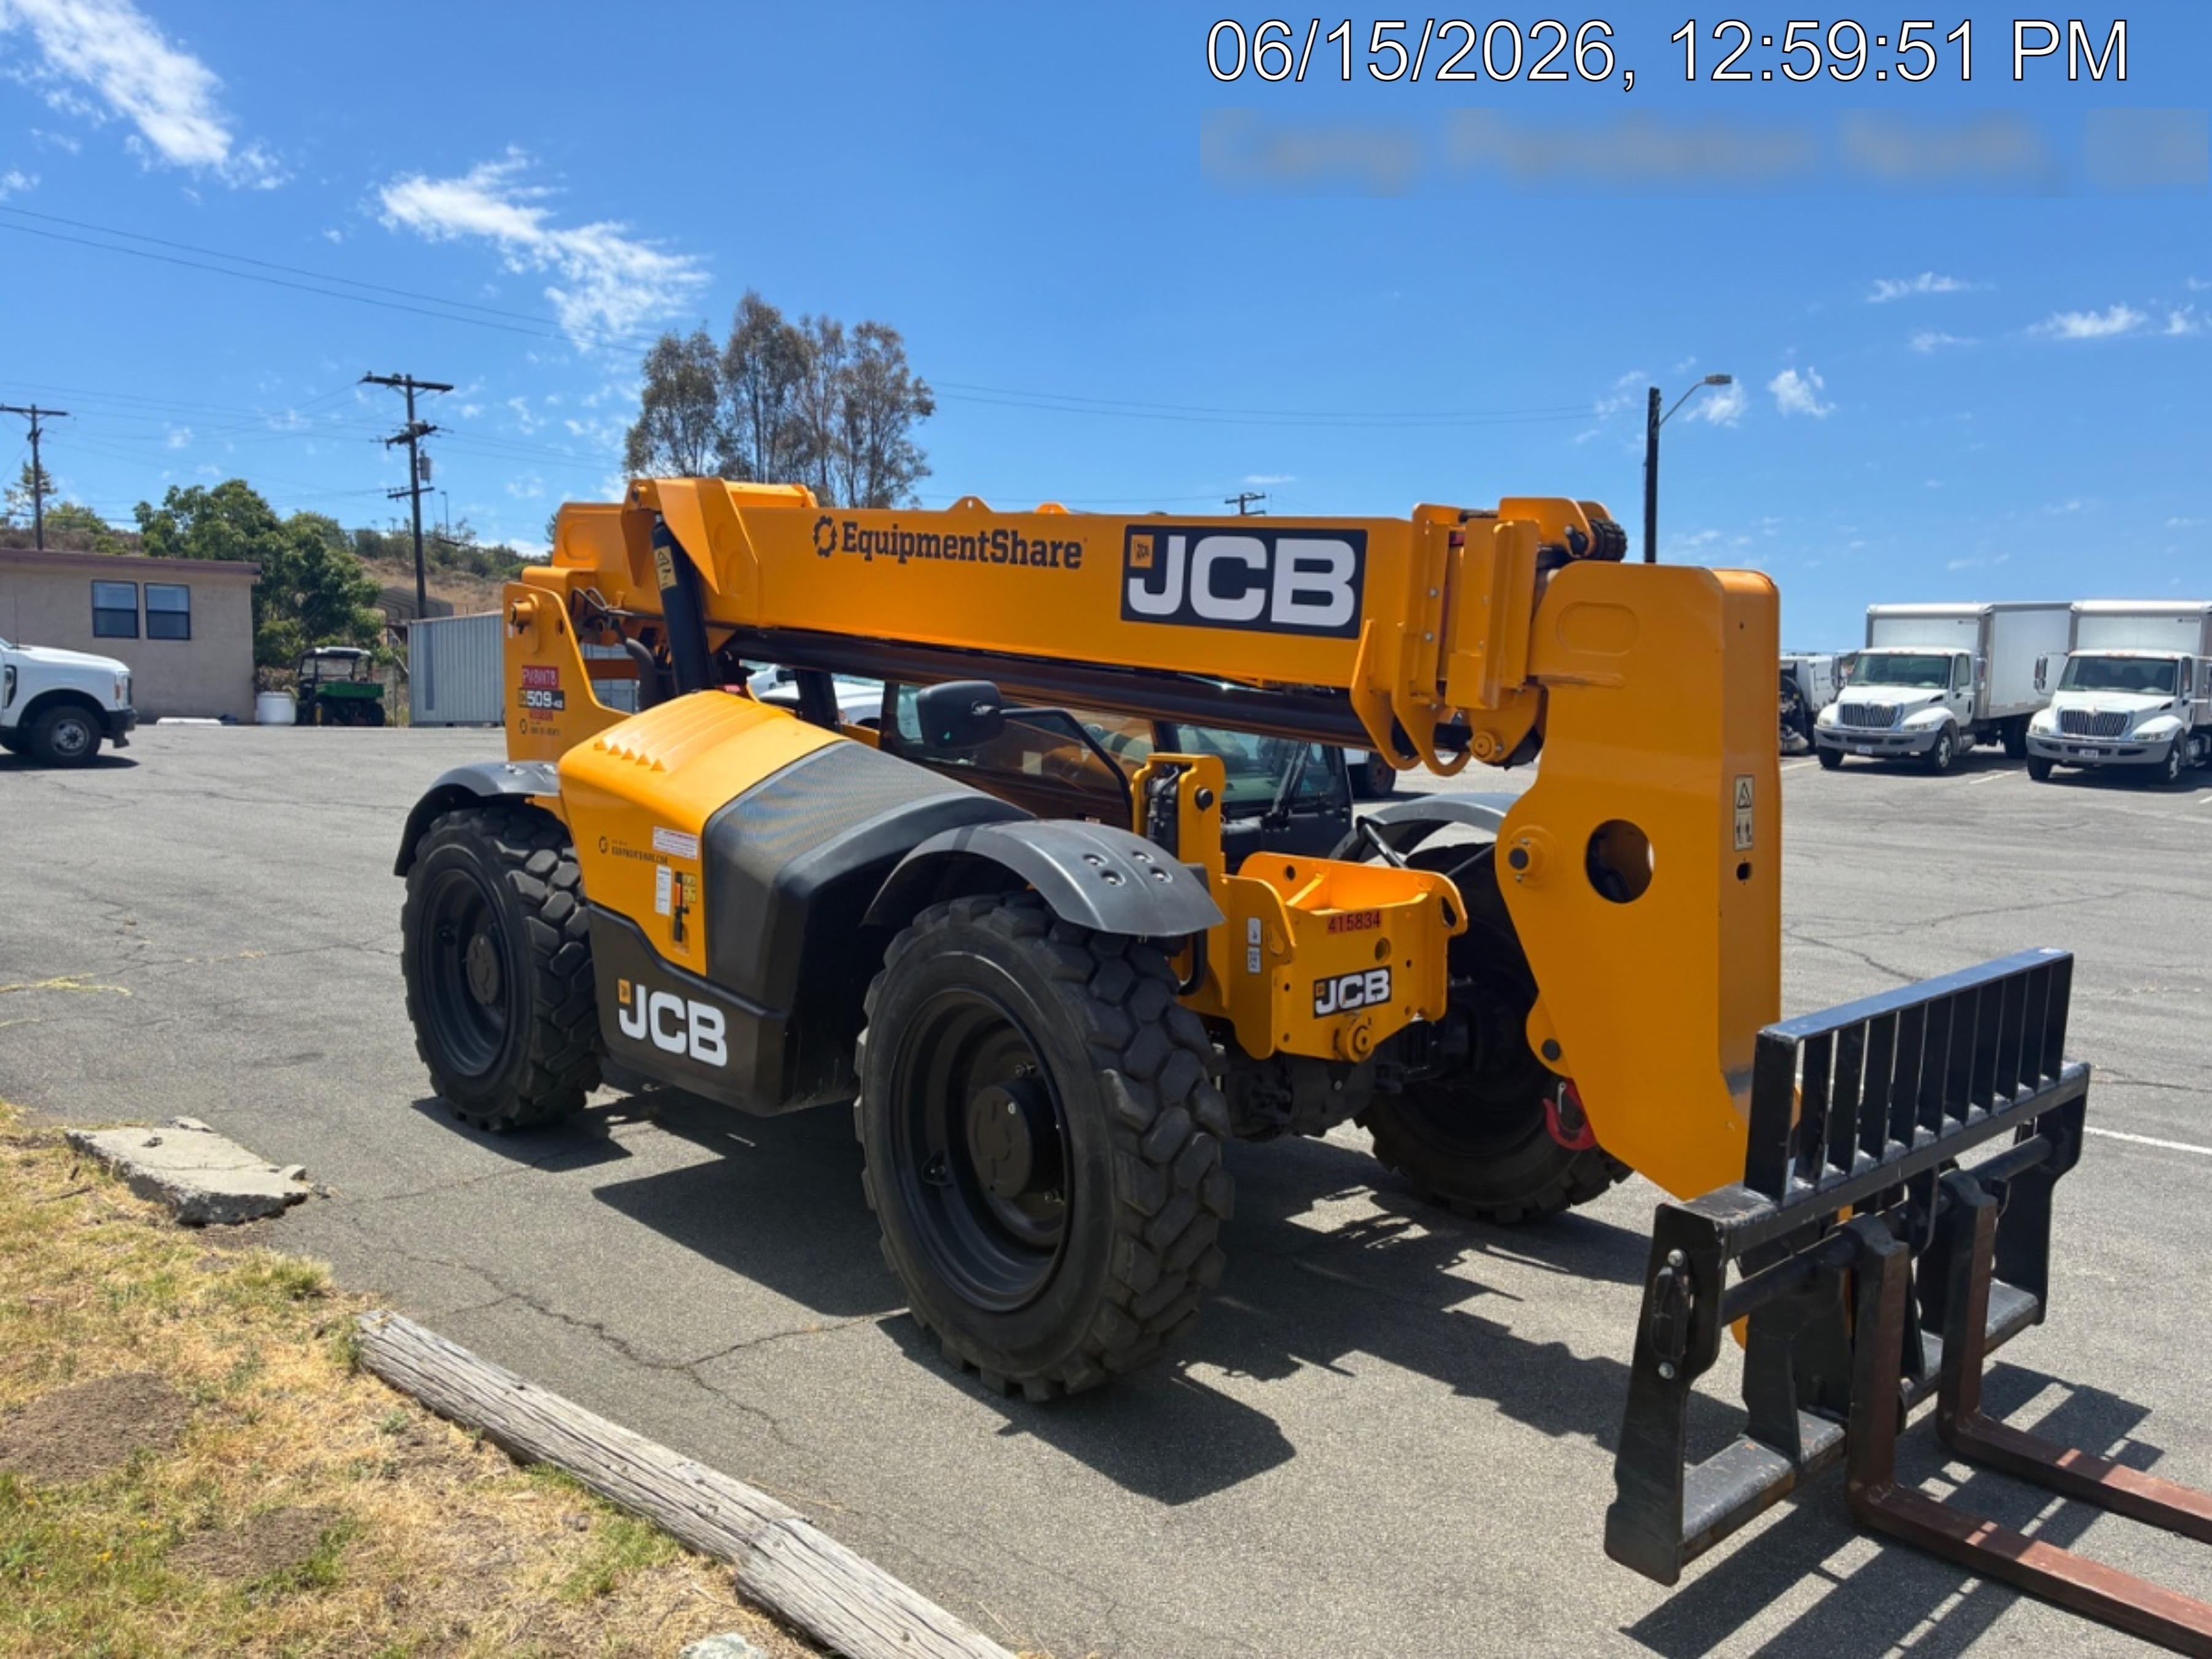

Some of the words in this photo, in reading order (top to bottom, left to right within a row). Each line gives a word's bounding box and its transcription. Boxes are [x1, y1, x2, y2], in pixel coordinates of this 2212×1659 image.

[842, 521, 1083, 569] EquipmentShare
[1128, 535, 1355, 627] JCB
[1328, 911, 1380, 933] 415834
[1315, 969, 1390, 1014] JCB
[619, 983, 728, 1067] JCB
